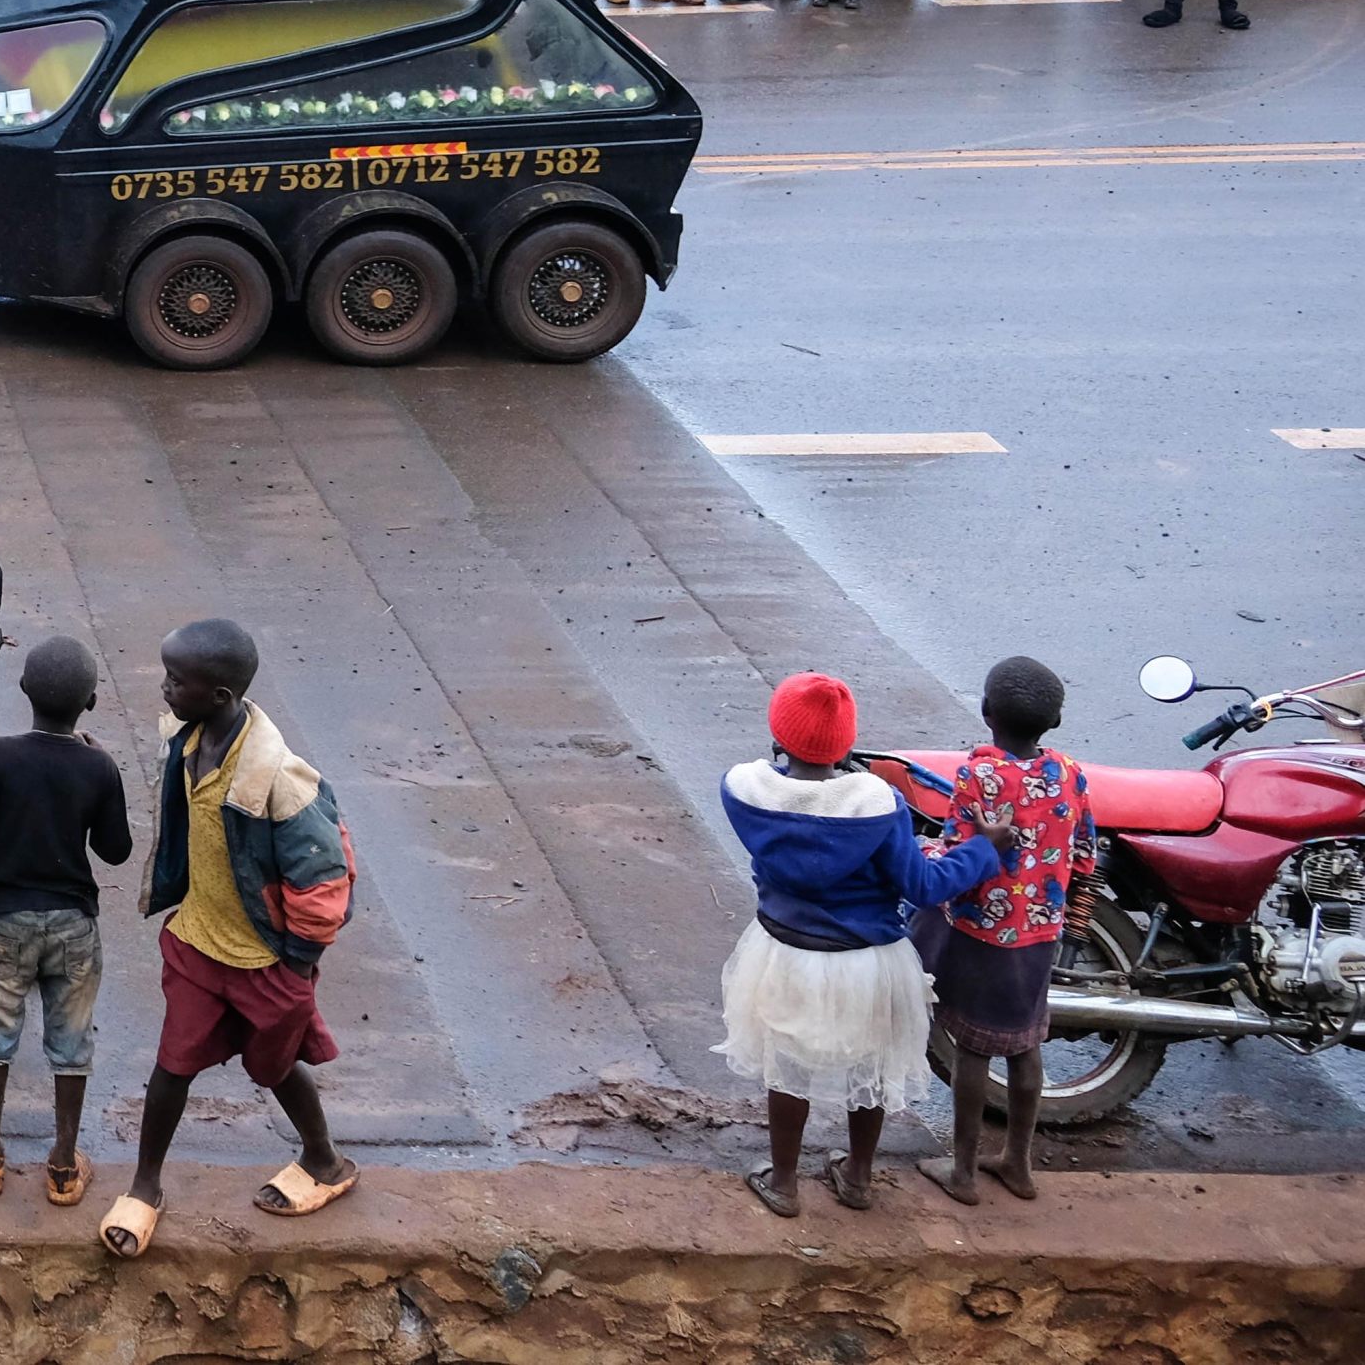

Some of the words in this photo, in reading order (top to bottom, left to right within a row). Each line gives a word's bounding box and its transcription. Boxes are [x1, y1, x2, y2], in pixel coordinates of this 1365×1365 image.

[110, 171, 196, 201] 0735
[205, 165, 270, 196] 547
[279, 162, 344, 192] 582
[368, 155, 450, 186] 0712
[459, 150, 526, 180] 547
[534, 147, 601, 176] 582
